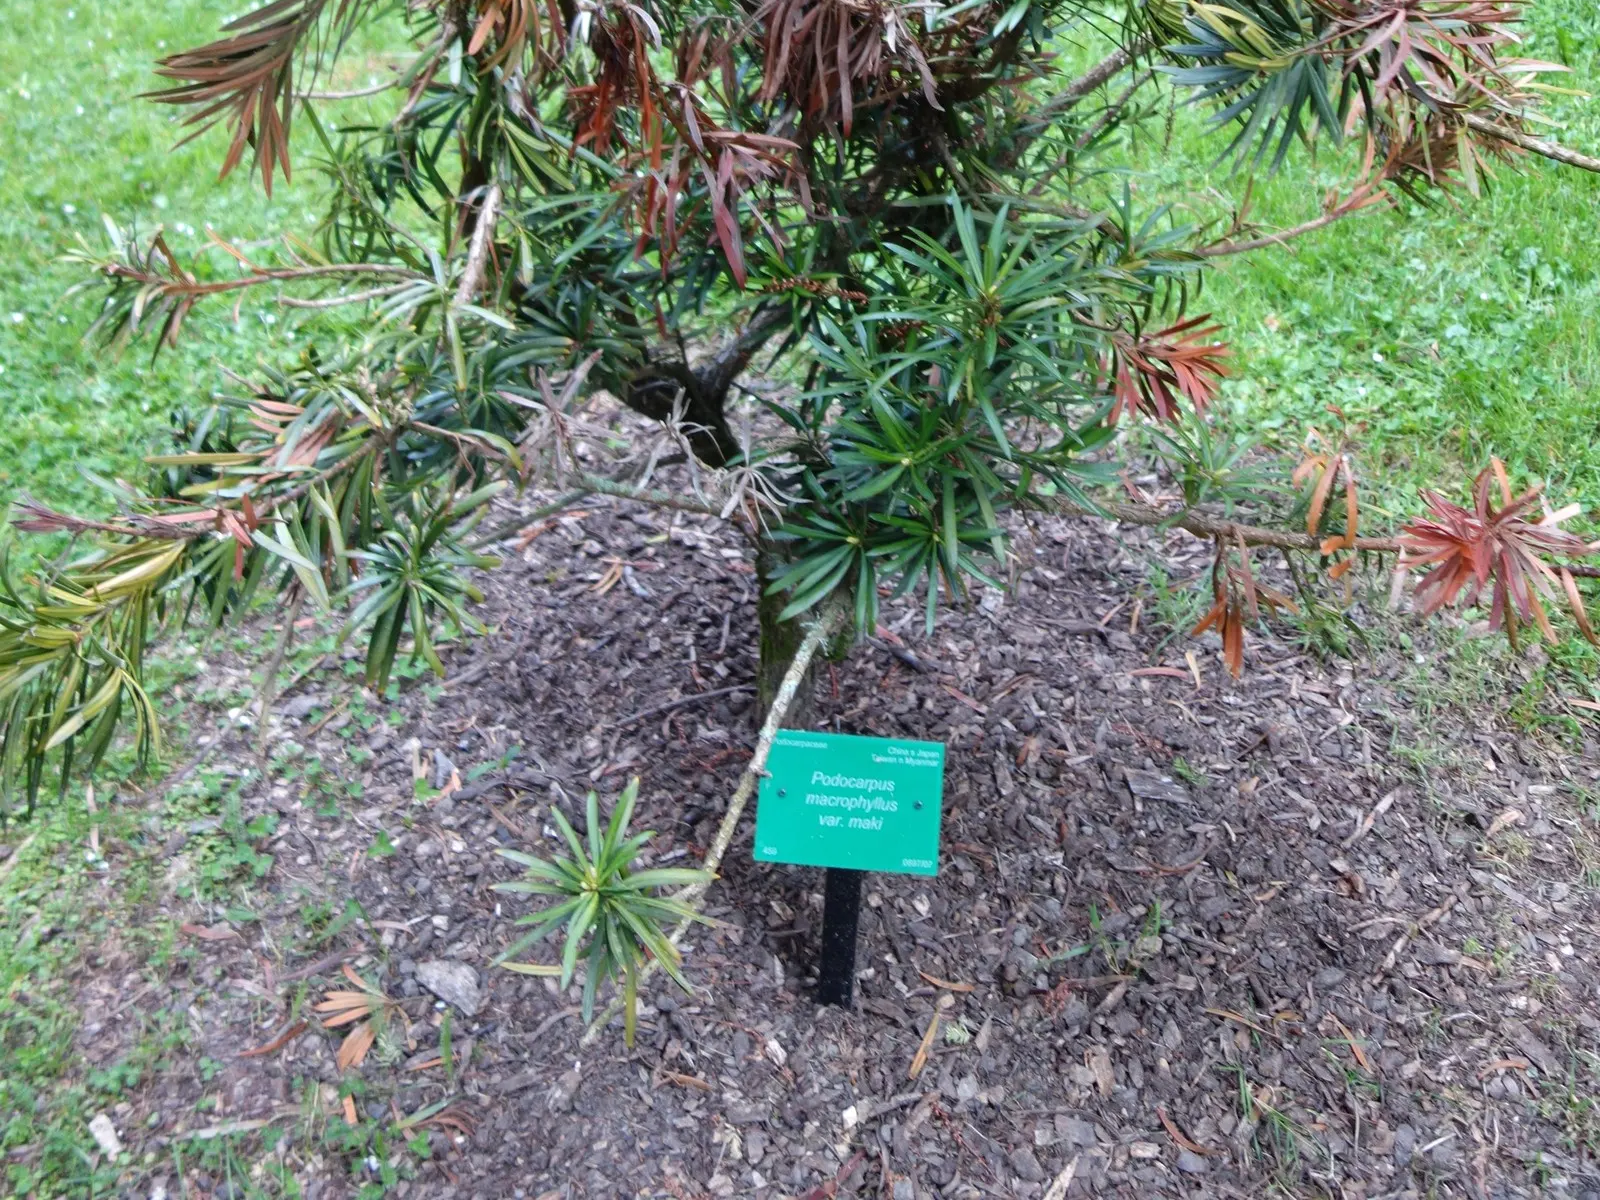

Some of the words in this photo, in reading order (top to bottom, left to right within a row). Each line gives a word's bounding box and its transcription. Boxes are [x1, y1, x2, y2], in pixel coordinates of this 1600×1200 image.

[887, 746, 909, 756] China
[918, 750, 940, 758] Japan
[905, 757, 939, 767] Myanmar
[811, 772, 895, 792] Podocarpus
[806, 793, 898, 813] macrophyllus
[819, 815, 843, 827] var.
[848, 817, 884, 830] maki
